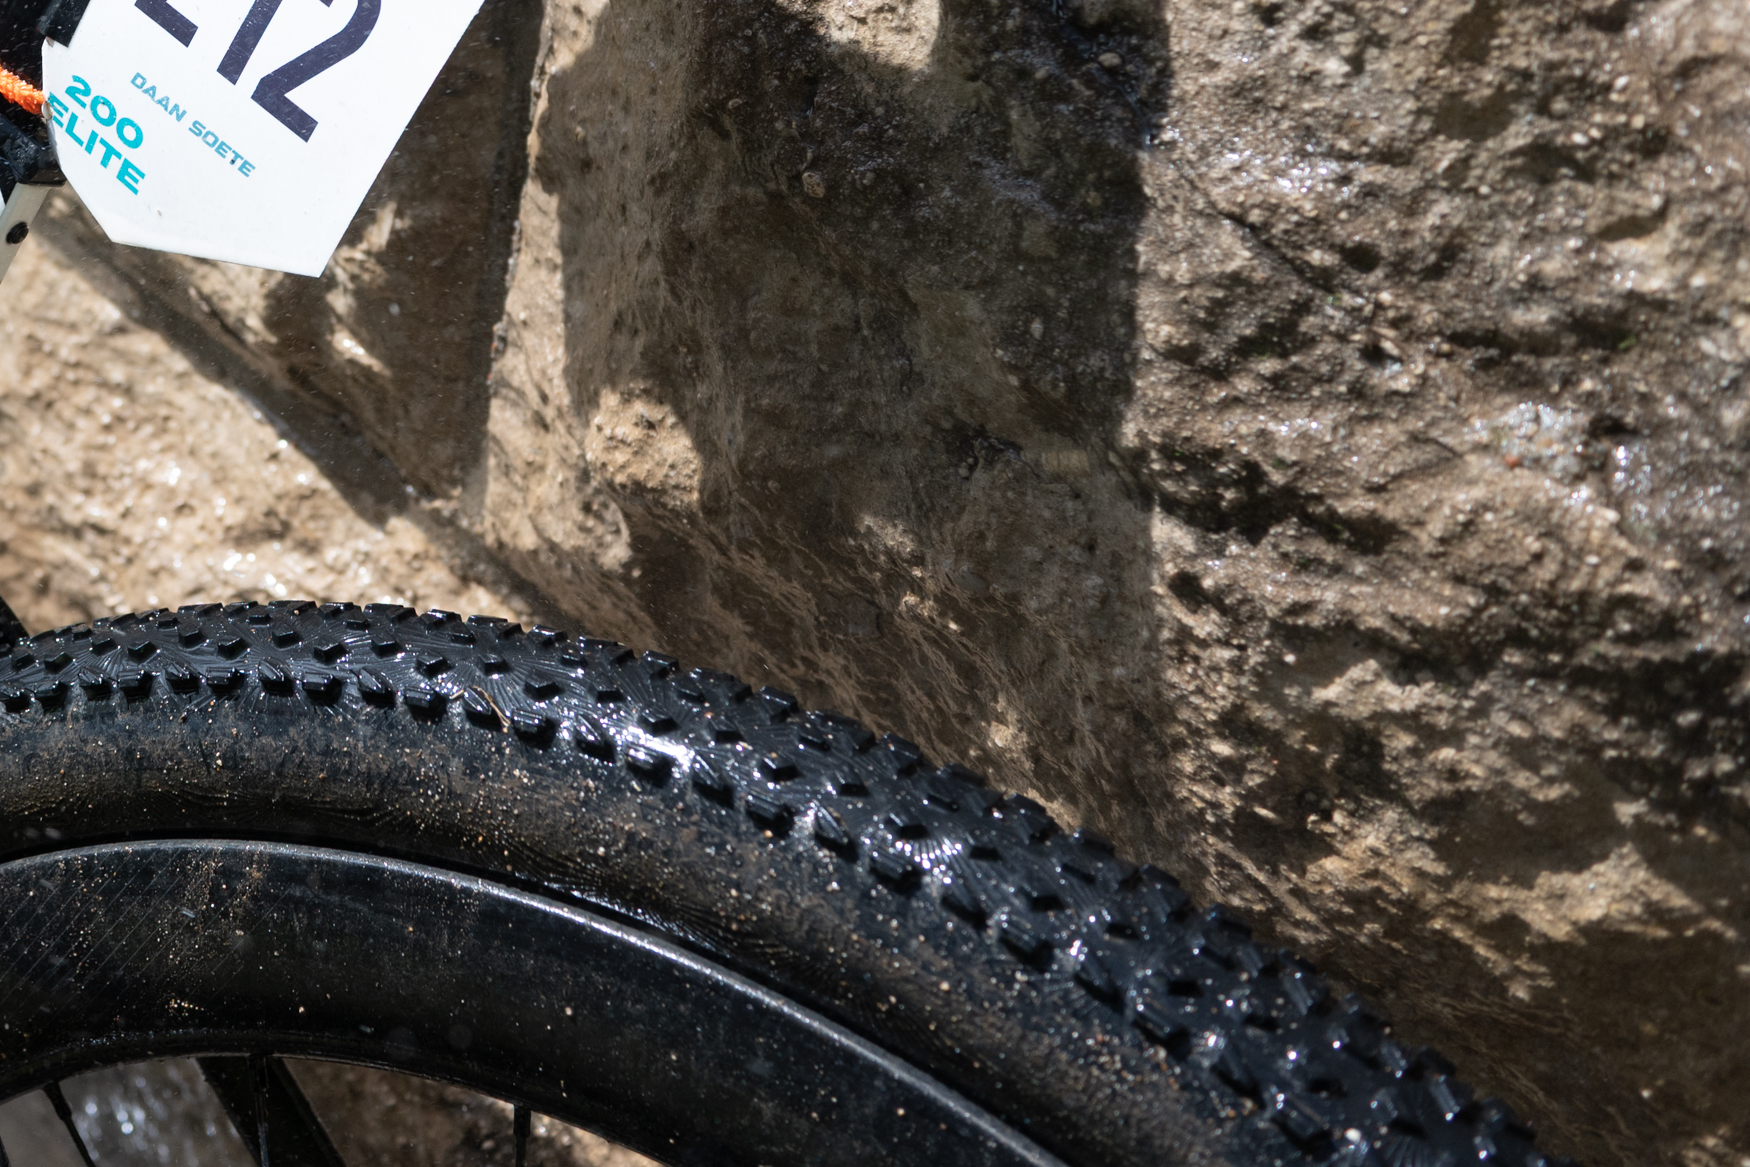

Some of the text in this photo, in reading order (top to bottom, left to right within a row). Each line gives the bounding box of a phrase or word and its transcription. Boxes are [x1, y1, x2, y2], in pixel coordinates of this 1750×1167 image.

[47, 92, 146, 196] ELITE
[65, 75, 144, 149] 200
[130, 72, 256, 178] DAAN SOETE
